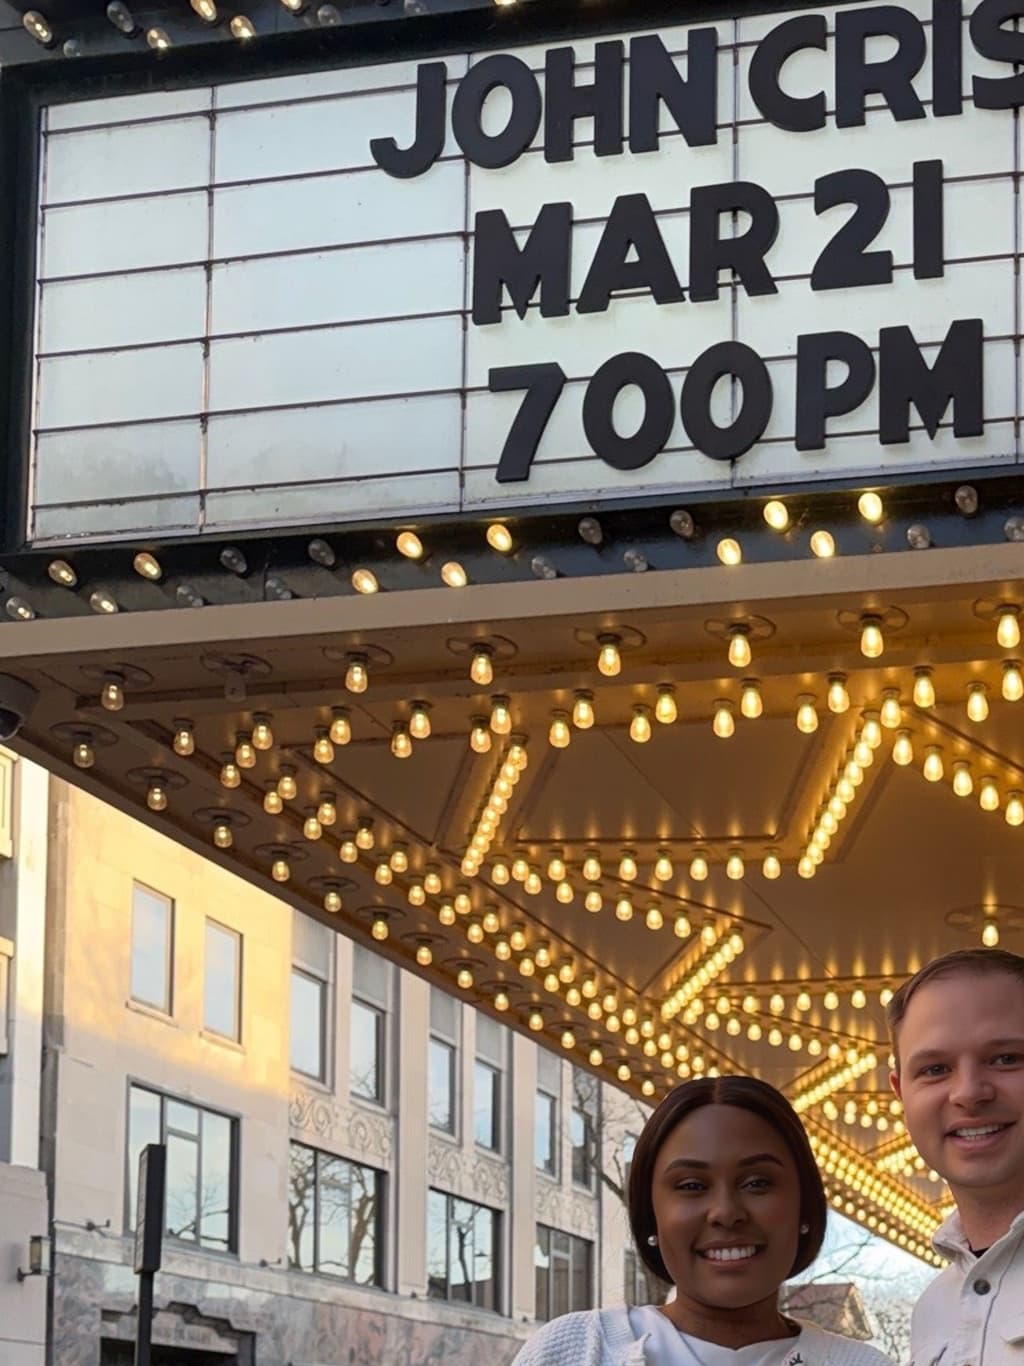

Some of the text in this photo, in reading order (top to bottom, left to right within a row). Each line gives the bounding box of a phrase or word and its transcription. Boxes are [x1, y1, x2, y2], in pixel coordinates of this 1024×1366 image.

[370, 27, 718, 179] JOHN
[472, 159, 945, 325] MAR 21
[488, 318, 985, 484] 700 PM
